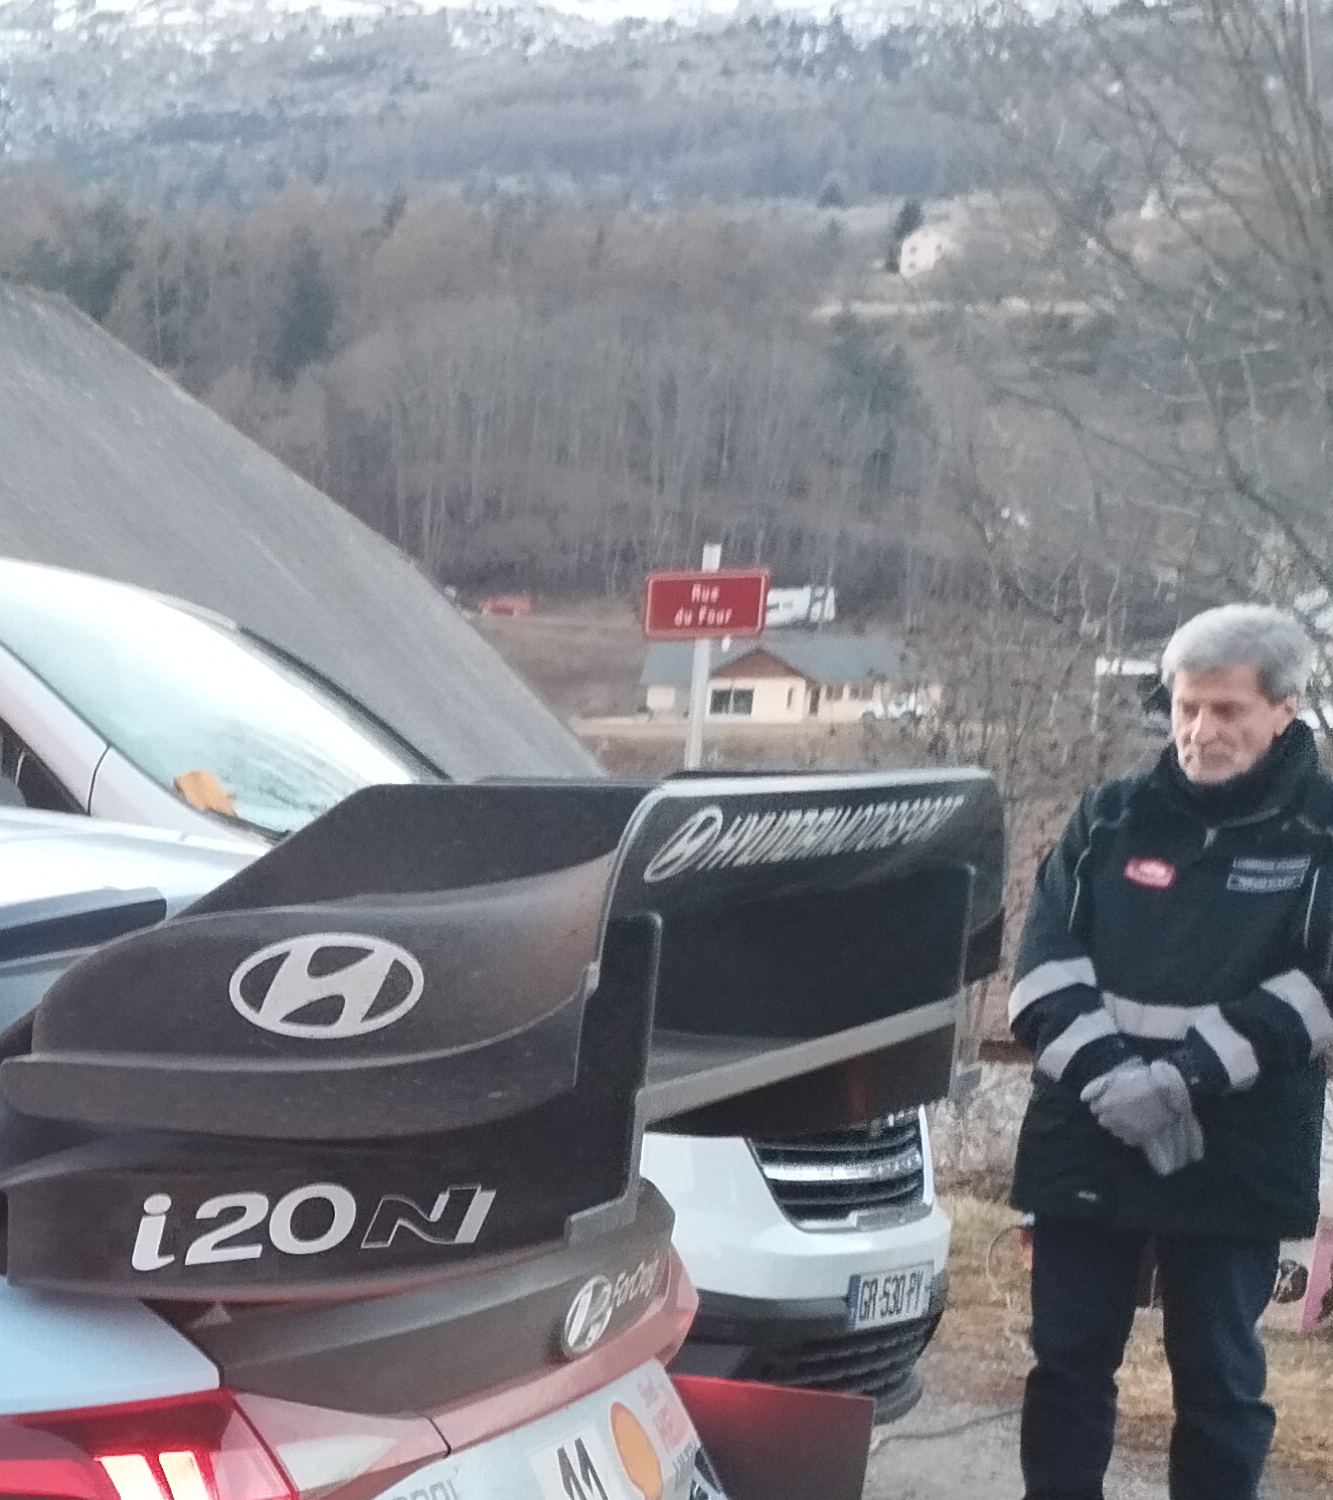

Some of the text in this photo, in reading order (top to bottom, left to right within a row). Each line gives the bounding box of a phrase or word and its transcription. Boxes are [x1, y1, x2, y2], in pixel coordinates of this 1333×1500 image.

[691, 583, 720, 603] Rue
[674, 607, 733, 626] du Four
[131, 1184, 357, 1270] i20
